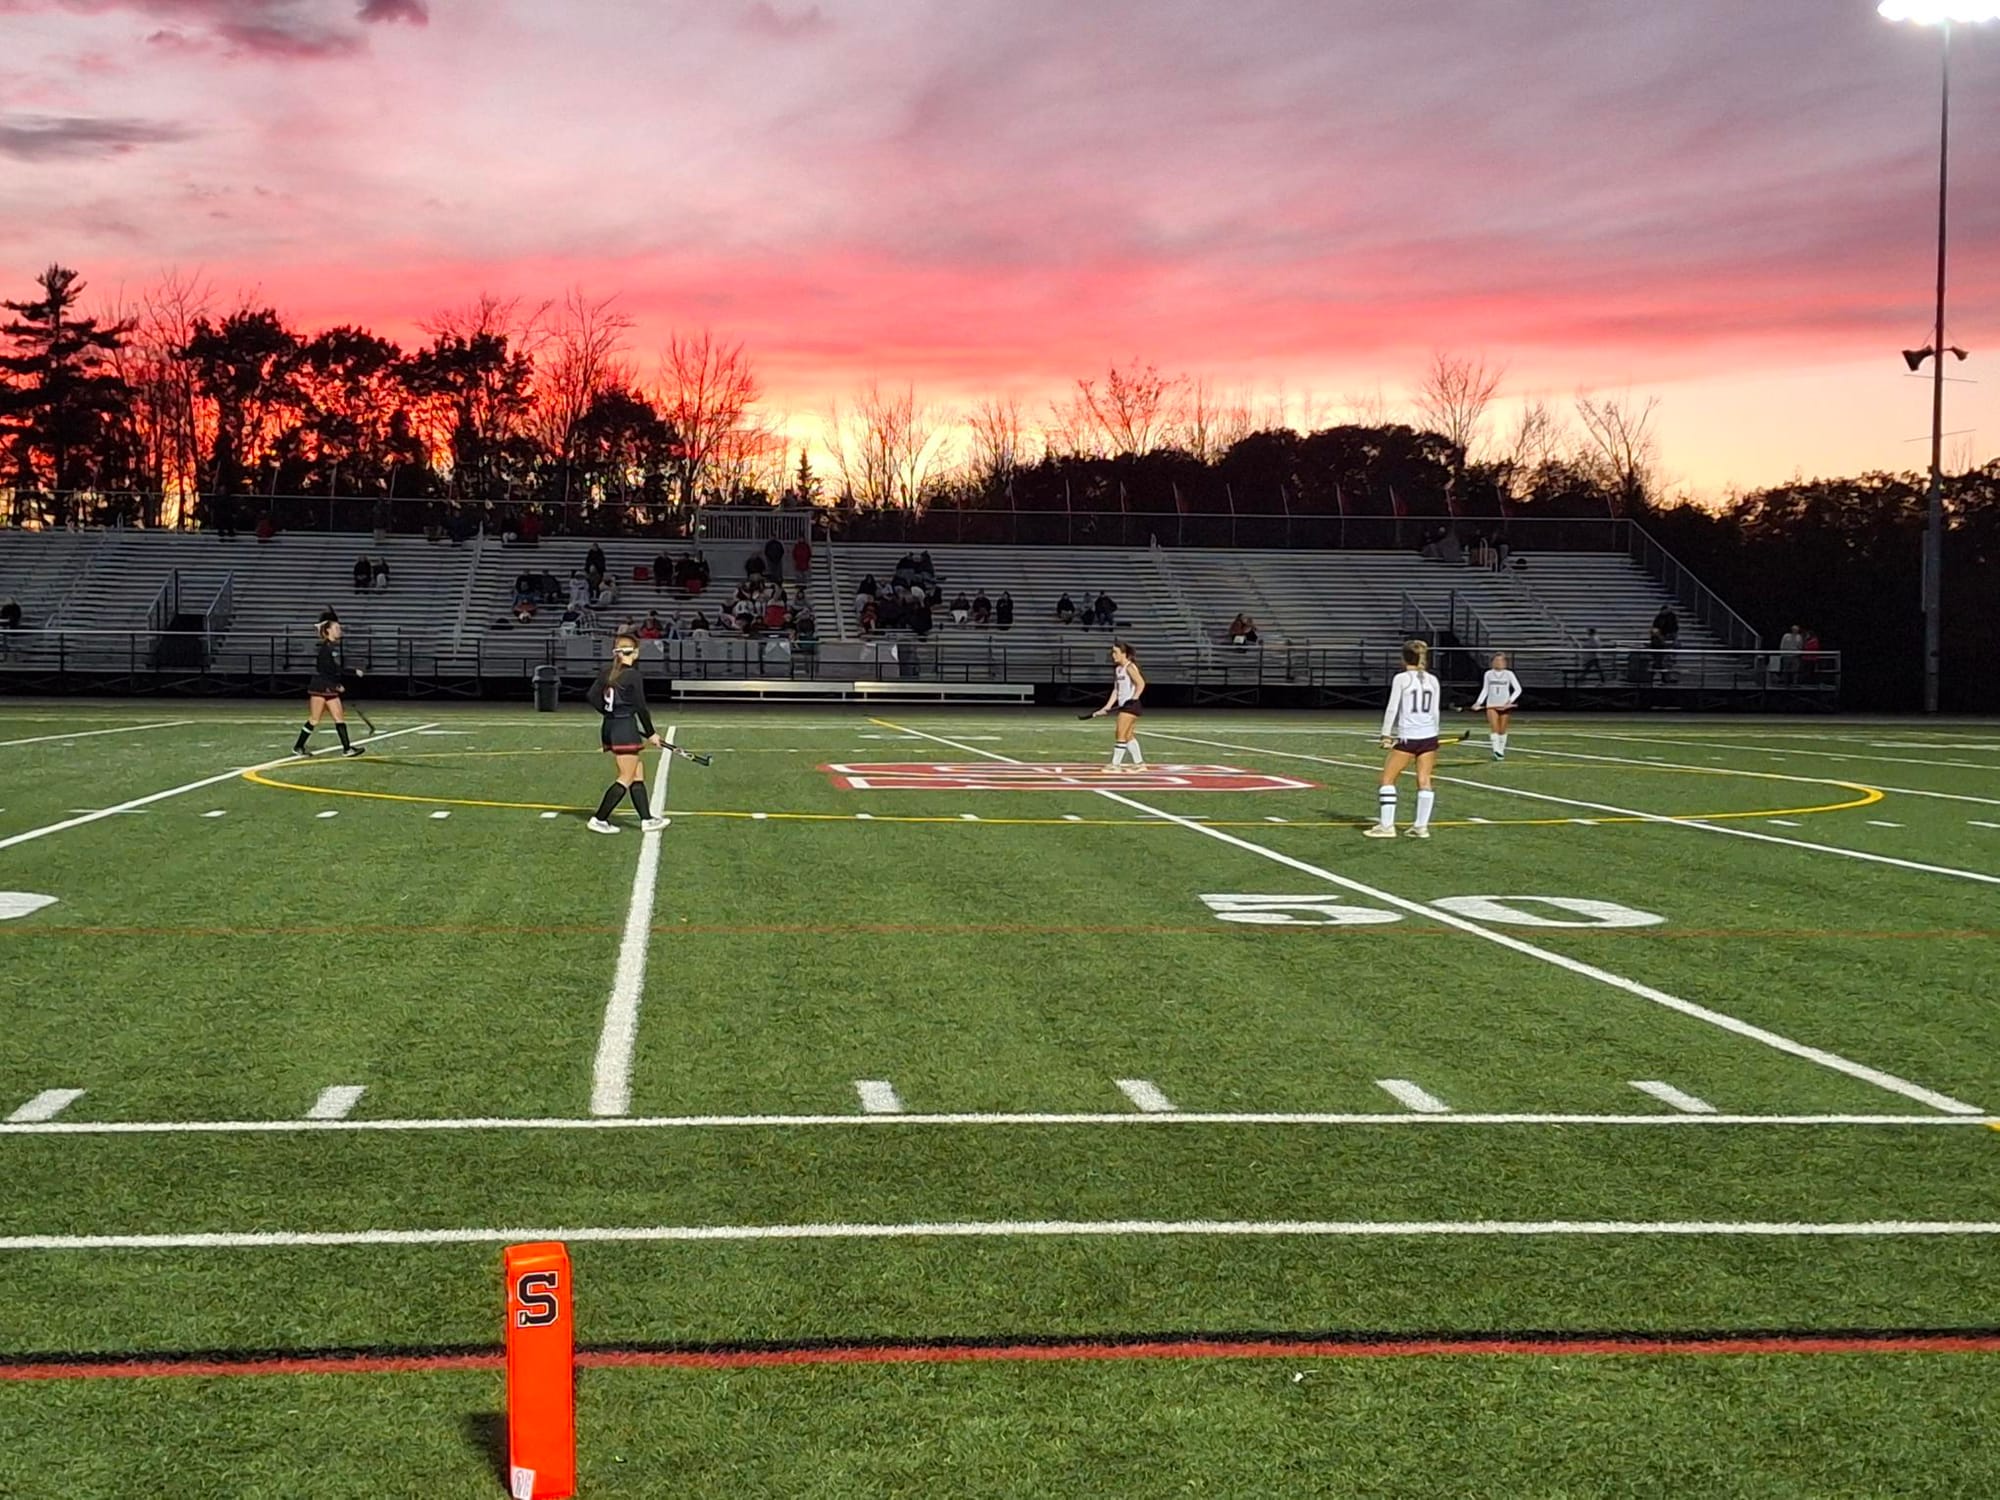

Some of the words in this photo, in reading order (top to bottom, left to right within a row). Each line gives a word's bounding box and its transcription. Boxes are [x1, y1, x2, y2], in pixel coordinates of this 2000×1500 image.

[604, 687, 614, 712] 9
[1410, 689, 1433, 713] 10
[1198, 892, 1668, 928] 50
[517, 1271, 558, 1327] S
